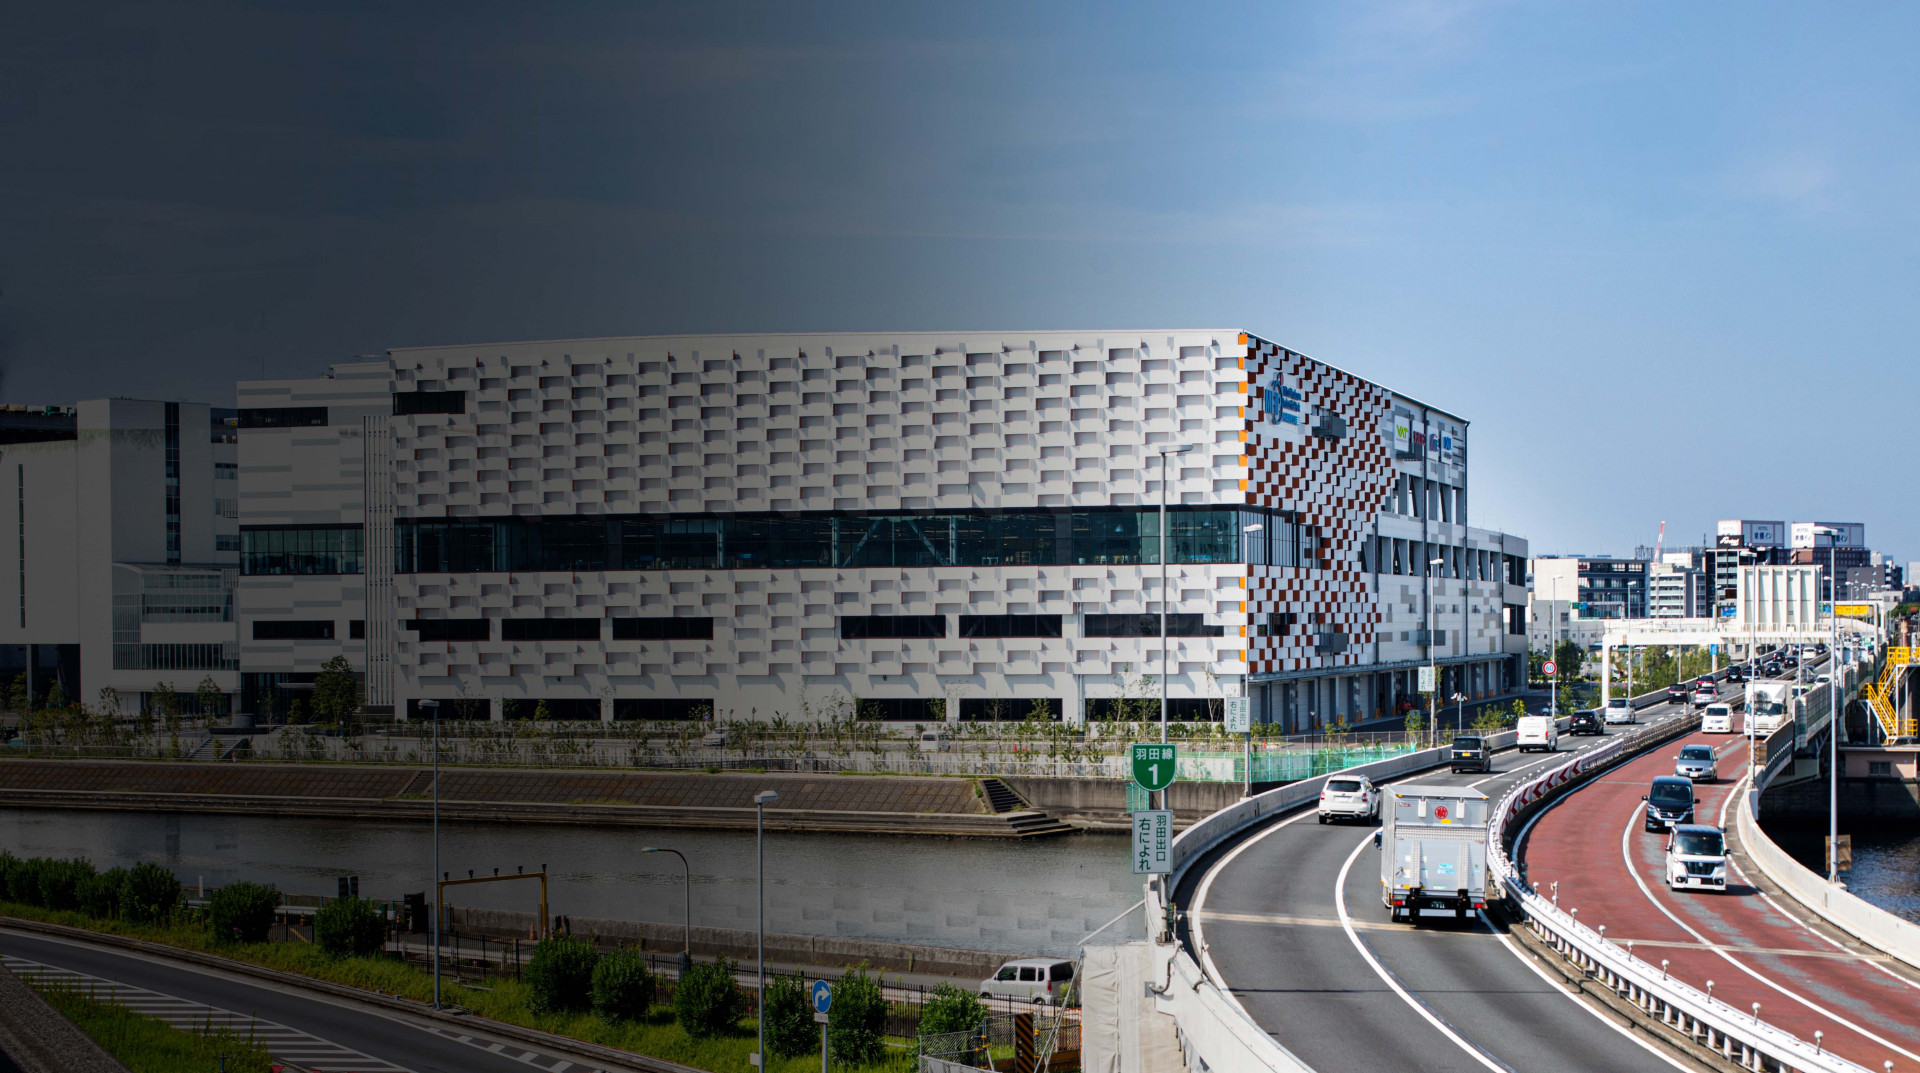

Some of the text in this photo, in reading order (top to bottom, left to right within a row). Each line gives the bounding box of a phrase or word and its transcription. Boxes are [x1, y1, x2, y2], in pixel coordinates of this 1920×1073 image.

[1135, 748, 1173, 760] 羽田線
[1148, 763, 1158, 786] 1
[1138, 817, 1151, 871] 右によれ
[1156, 814, 1167, 862] 羽田出口
